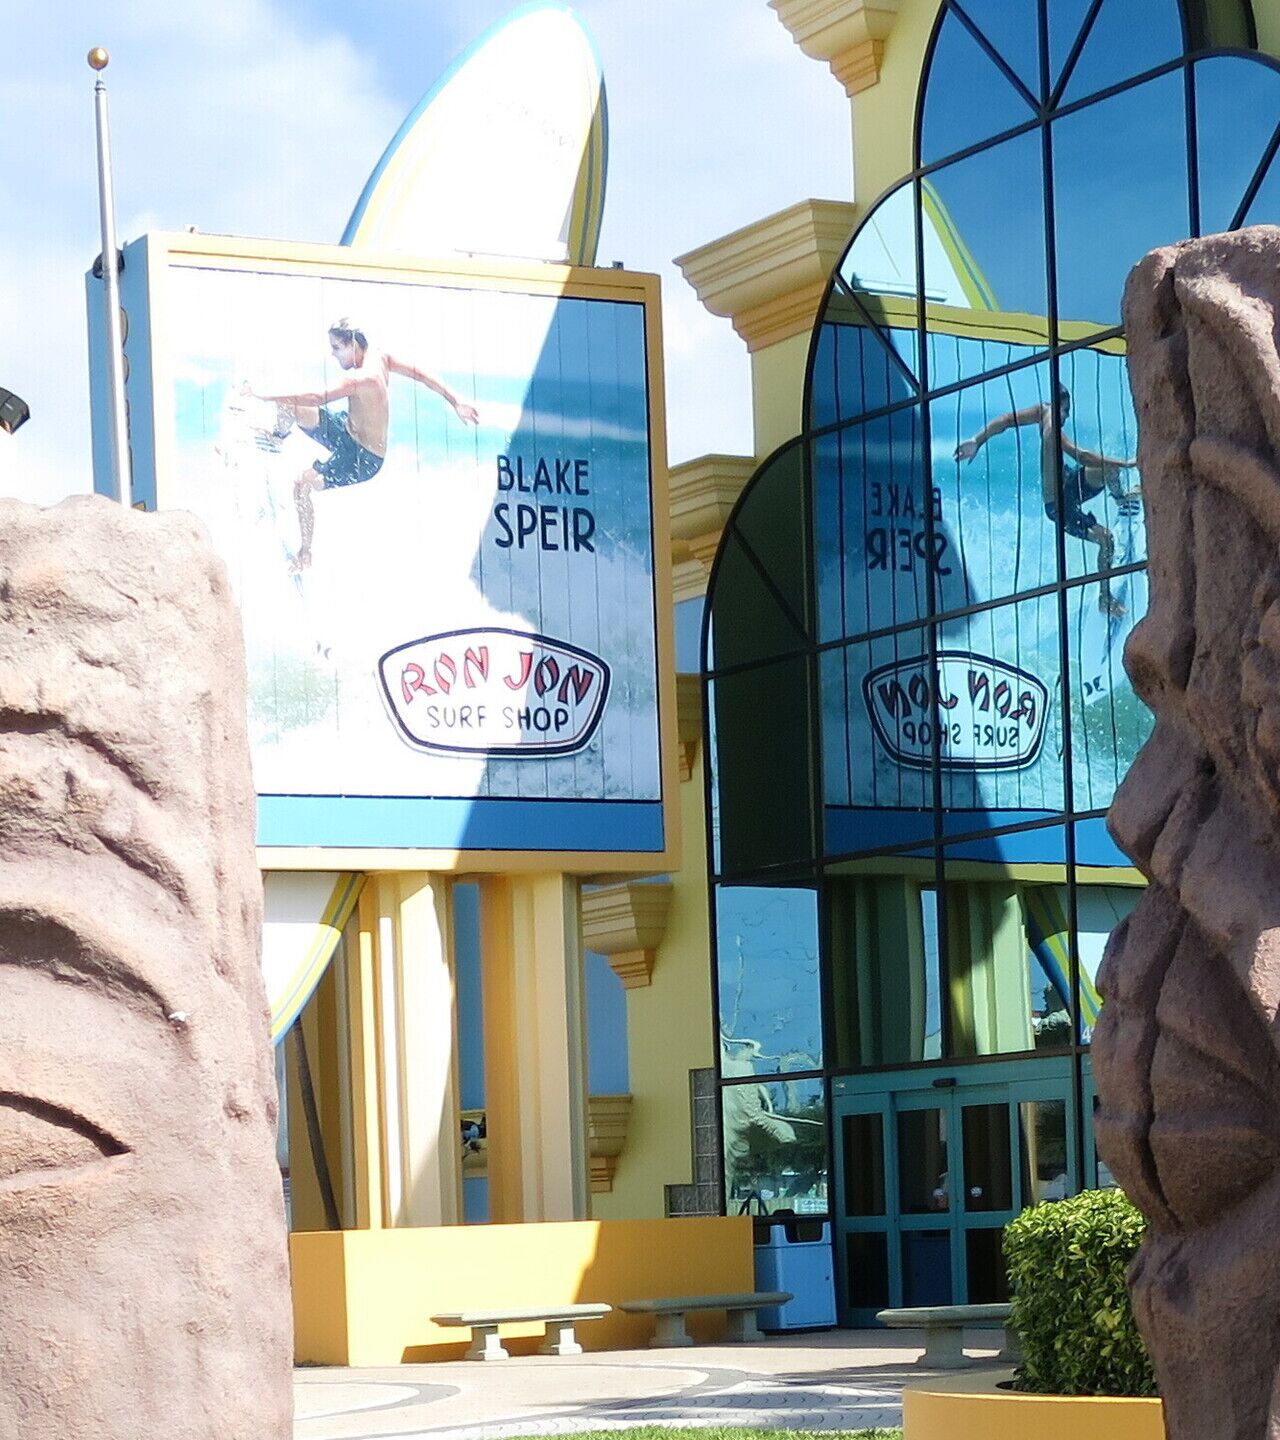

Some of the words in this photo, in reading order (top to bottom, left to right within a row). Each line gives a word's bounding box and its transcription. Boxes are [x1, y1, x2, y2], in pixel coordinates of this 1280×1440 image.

[497, 454, 590, 496] BLAKE
[494, 503, 596, 553] SPEIR
[400, 645, 489, 704] RON
[503, 651, 595, 707] JON
[426, 705, 487, 729] SURF
[503, 706, 569, 733] SHOP
